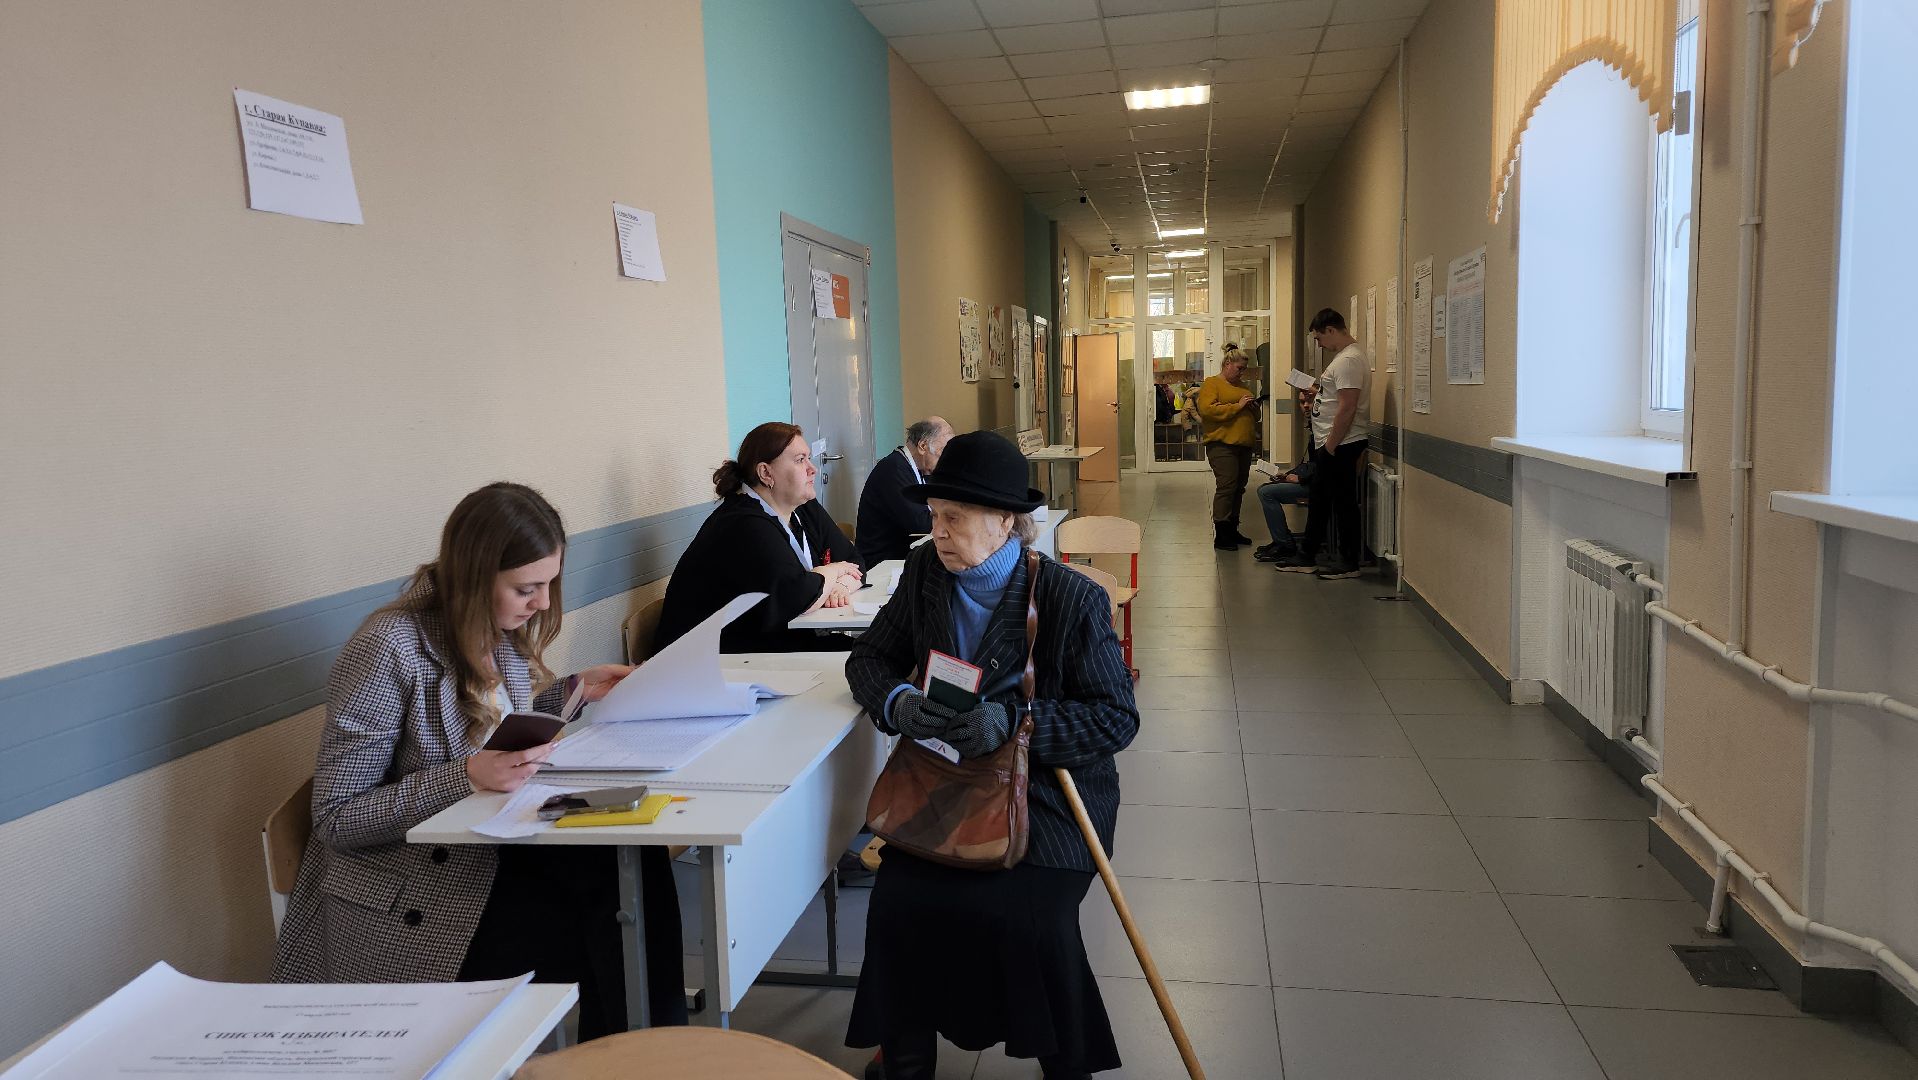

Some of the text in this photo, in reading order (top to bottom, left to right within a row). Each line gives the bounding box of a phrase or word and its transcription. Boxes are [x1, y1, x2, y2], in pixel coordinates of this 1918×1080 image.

[254, 104, 286, 122] Старая
[203, 1028, 409, 1040] СПИСОК ИЗБИРАТЕЛЕЙ
